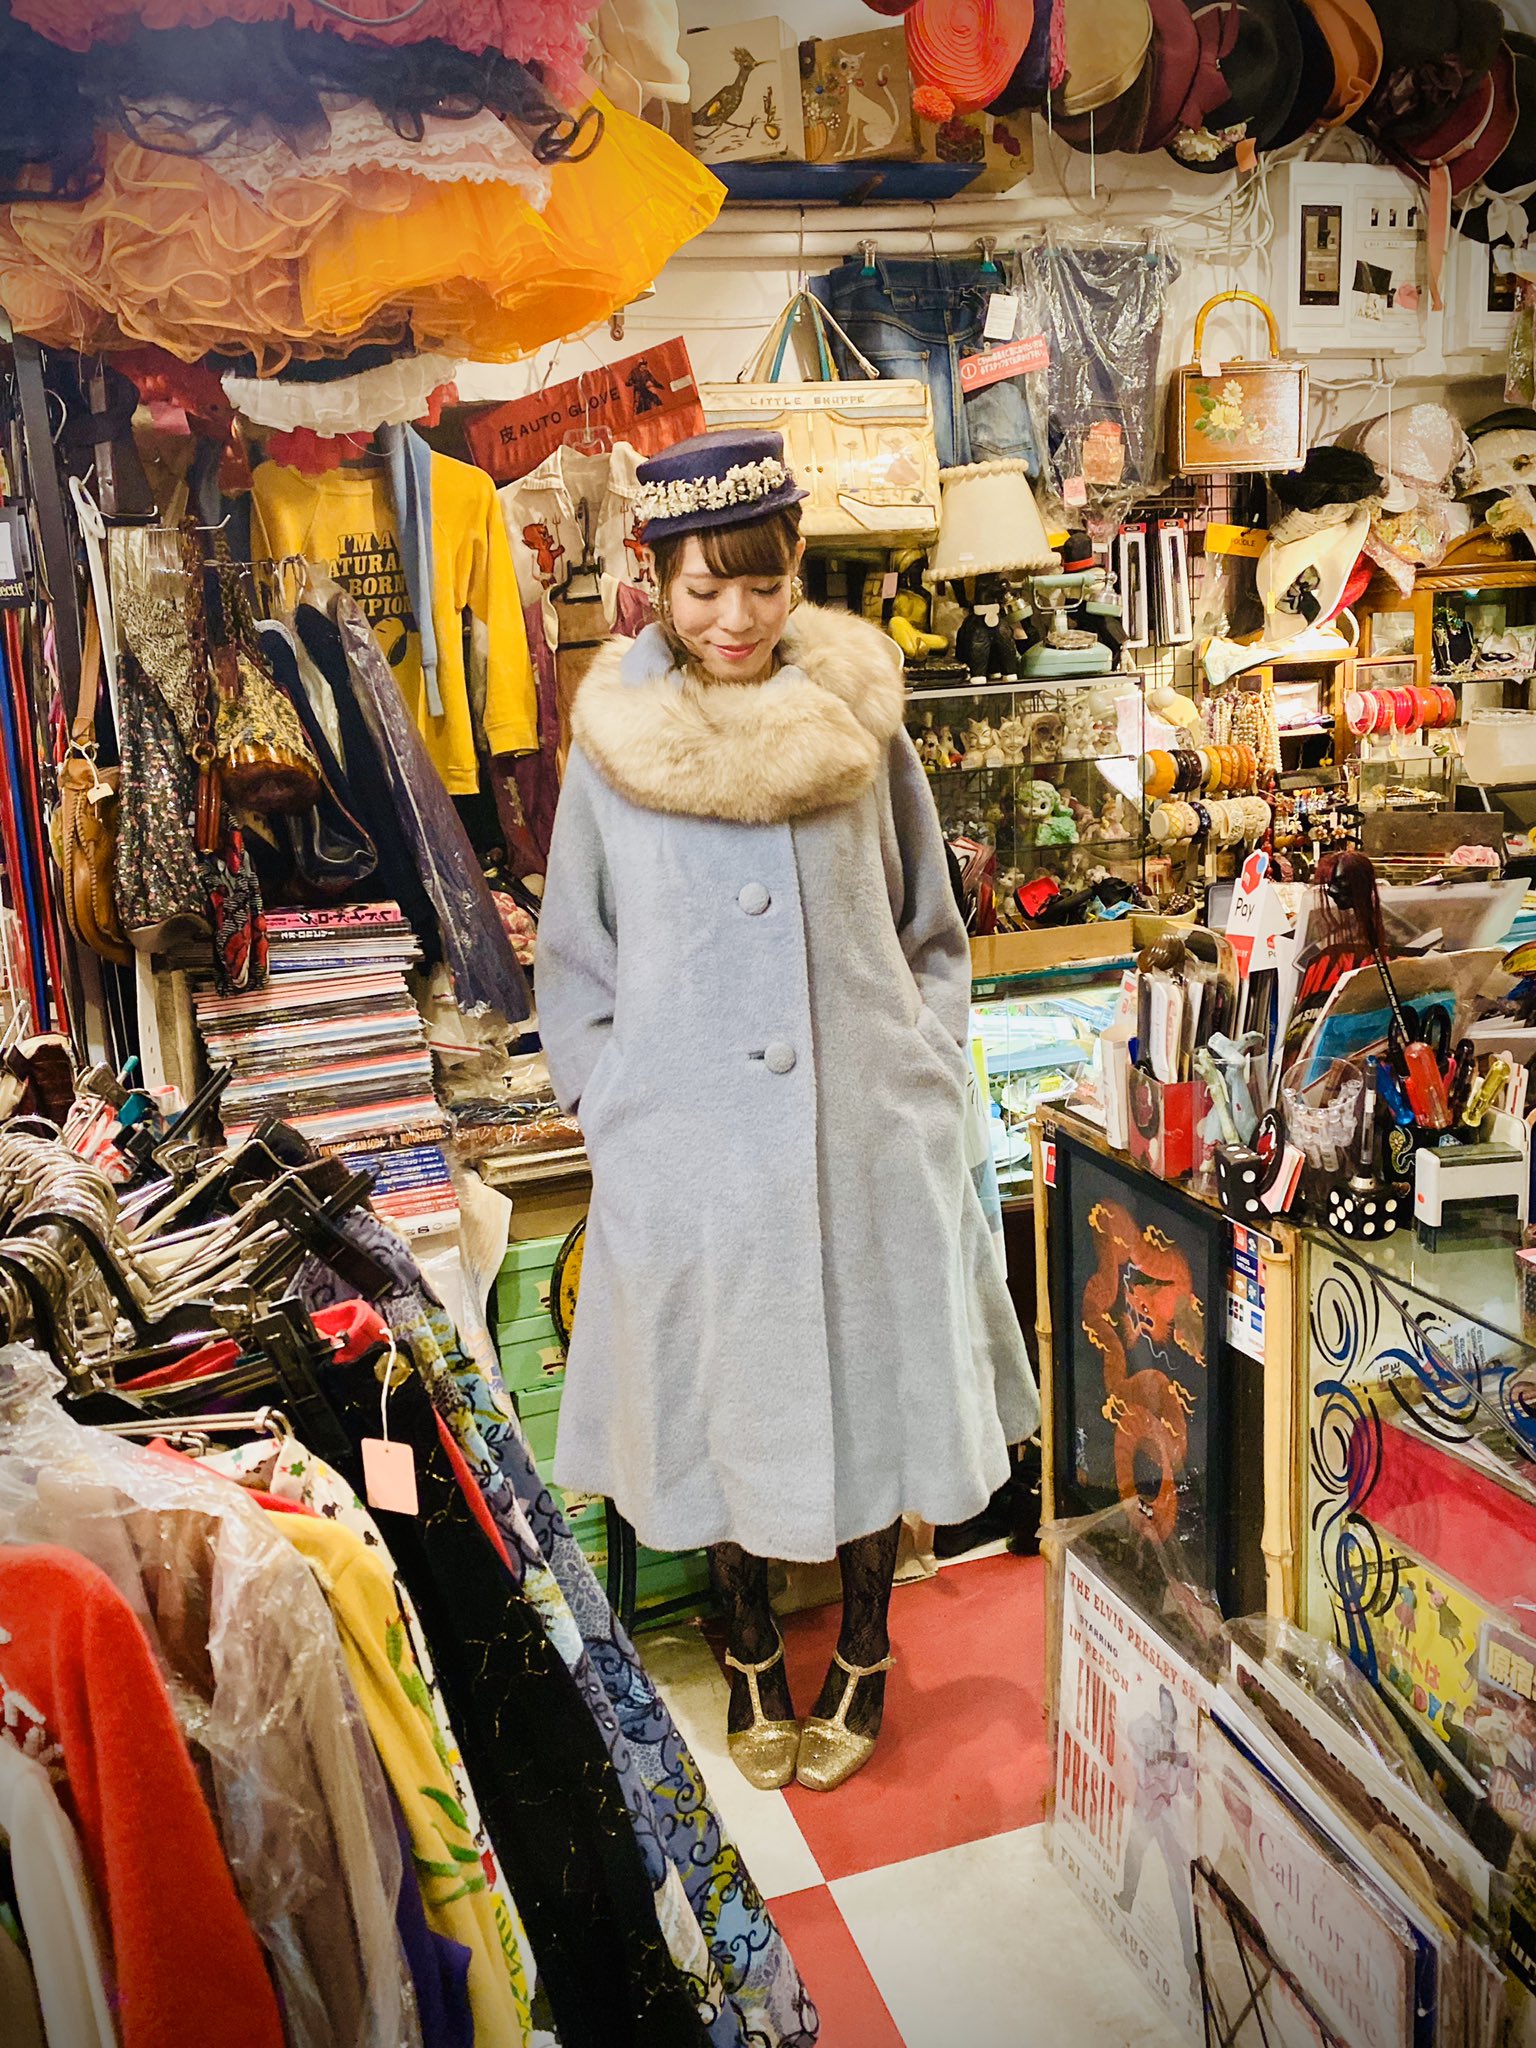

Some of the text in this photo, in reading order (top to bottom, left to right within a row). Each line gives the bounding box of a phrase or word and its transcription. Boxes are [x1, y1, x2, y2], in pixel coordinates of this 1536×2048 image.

[519, 410, 562, 436] AUTO
[568, 387, 620, 416] GLOVE
[750, 397, 802, 406] LITTLE
[328, 553, 400, 578] ATURA
[338, 530, 393, 554] I'M A
[0, 582, 24, 597] ectif
[1235, 897, 1255, 922] Pay
[1070, 1572, 1090, 1601] THE
[1093, 1593, 1124, 1634] ELVIS
[1127, 1626, 1178, 1685] PRESLEY
[1079, 1614, 1119, 1658] STARRING
[1068, 1624, 1129, 1693] IN PERSON
[1488, 1640, 1536, 1702] 原宿
[1076, 1657, 1118, 1768] ELVIS
[1062, 1730, 1125, 1867] PRESLEY
[1093, 1887, 1116, 1926] SAT
[1120, 1924, 1148, 1969] AUG
[1155, 1967, 1170, 1997] 10
[1258, 1832, 1396, 2018] Call for the
